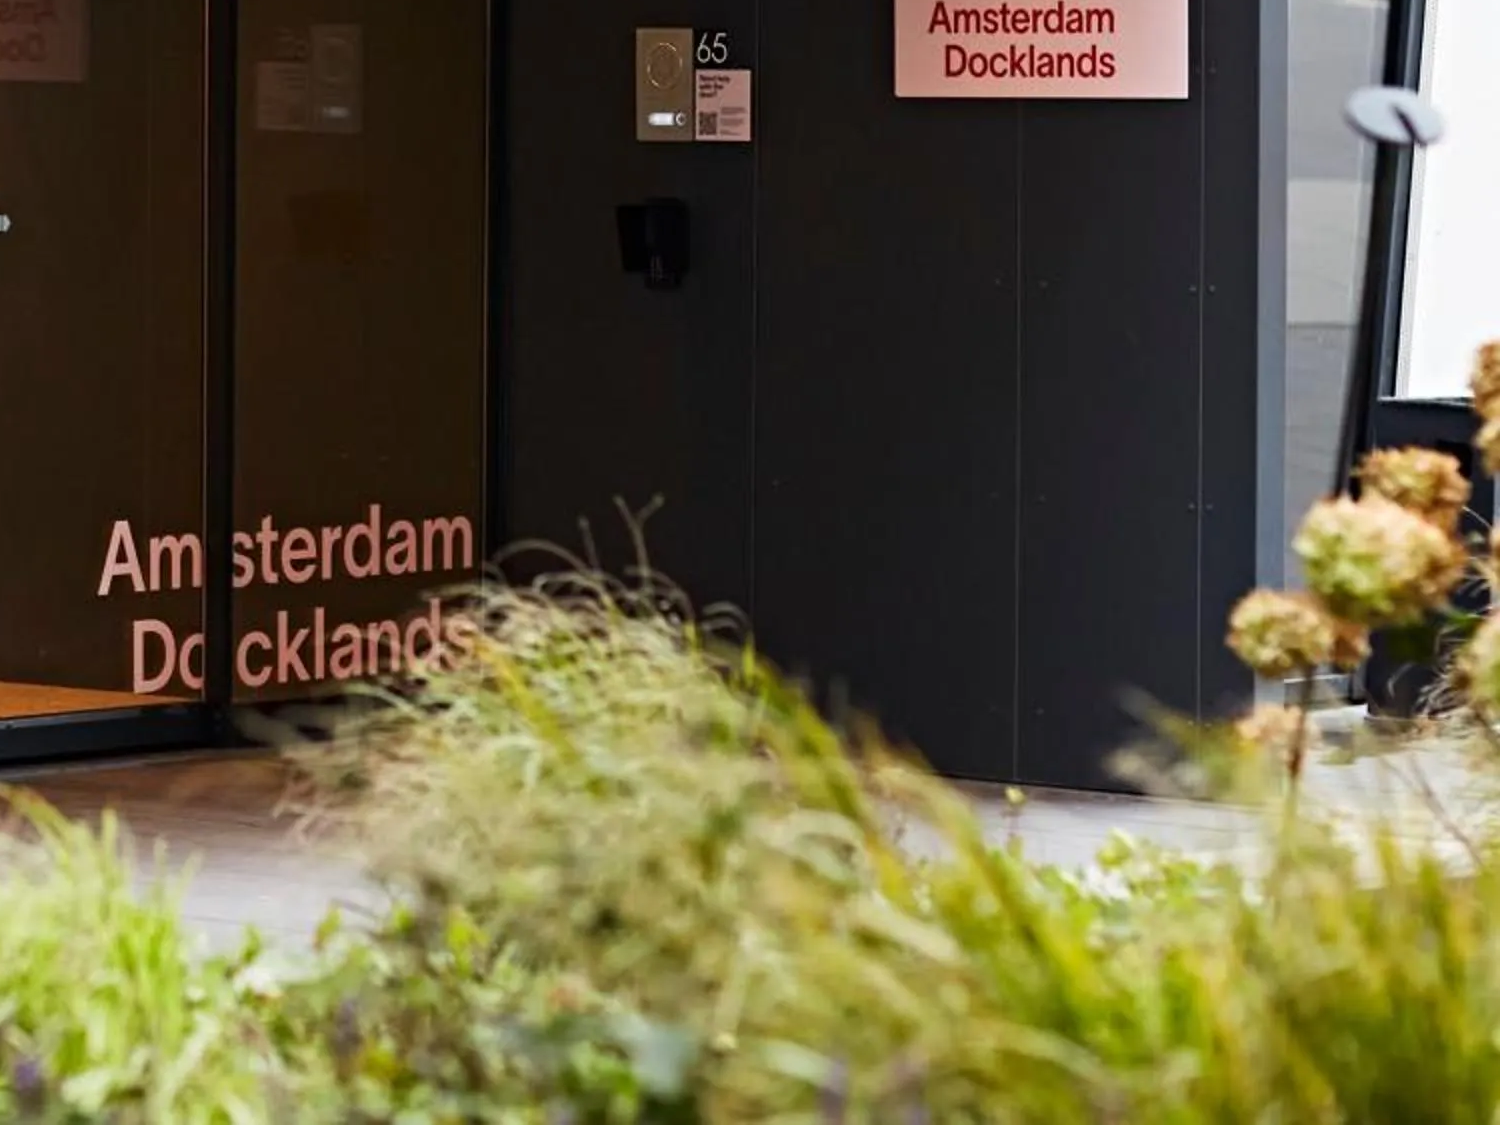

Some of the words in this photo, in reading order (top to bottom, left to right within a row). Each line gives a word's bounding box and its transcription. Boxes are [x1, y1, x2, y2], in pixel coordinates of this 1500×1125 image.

[928, 0, 1116, 34] Amsterdam
[696, 32, 729, 64] 65
[944, 43, 1117, 79] Docklands
[97, 503, 474, 596] Amsterdam
